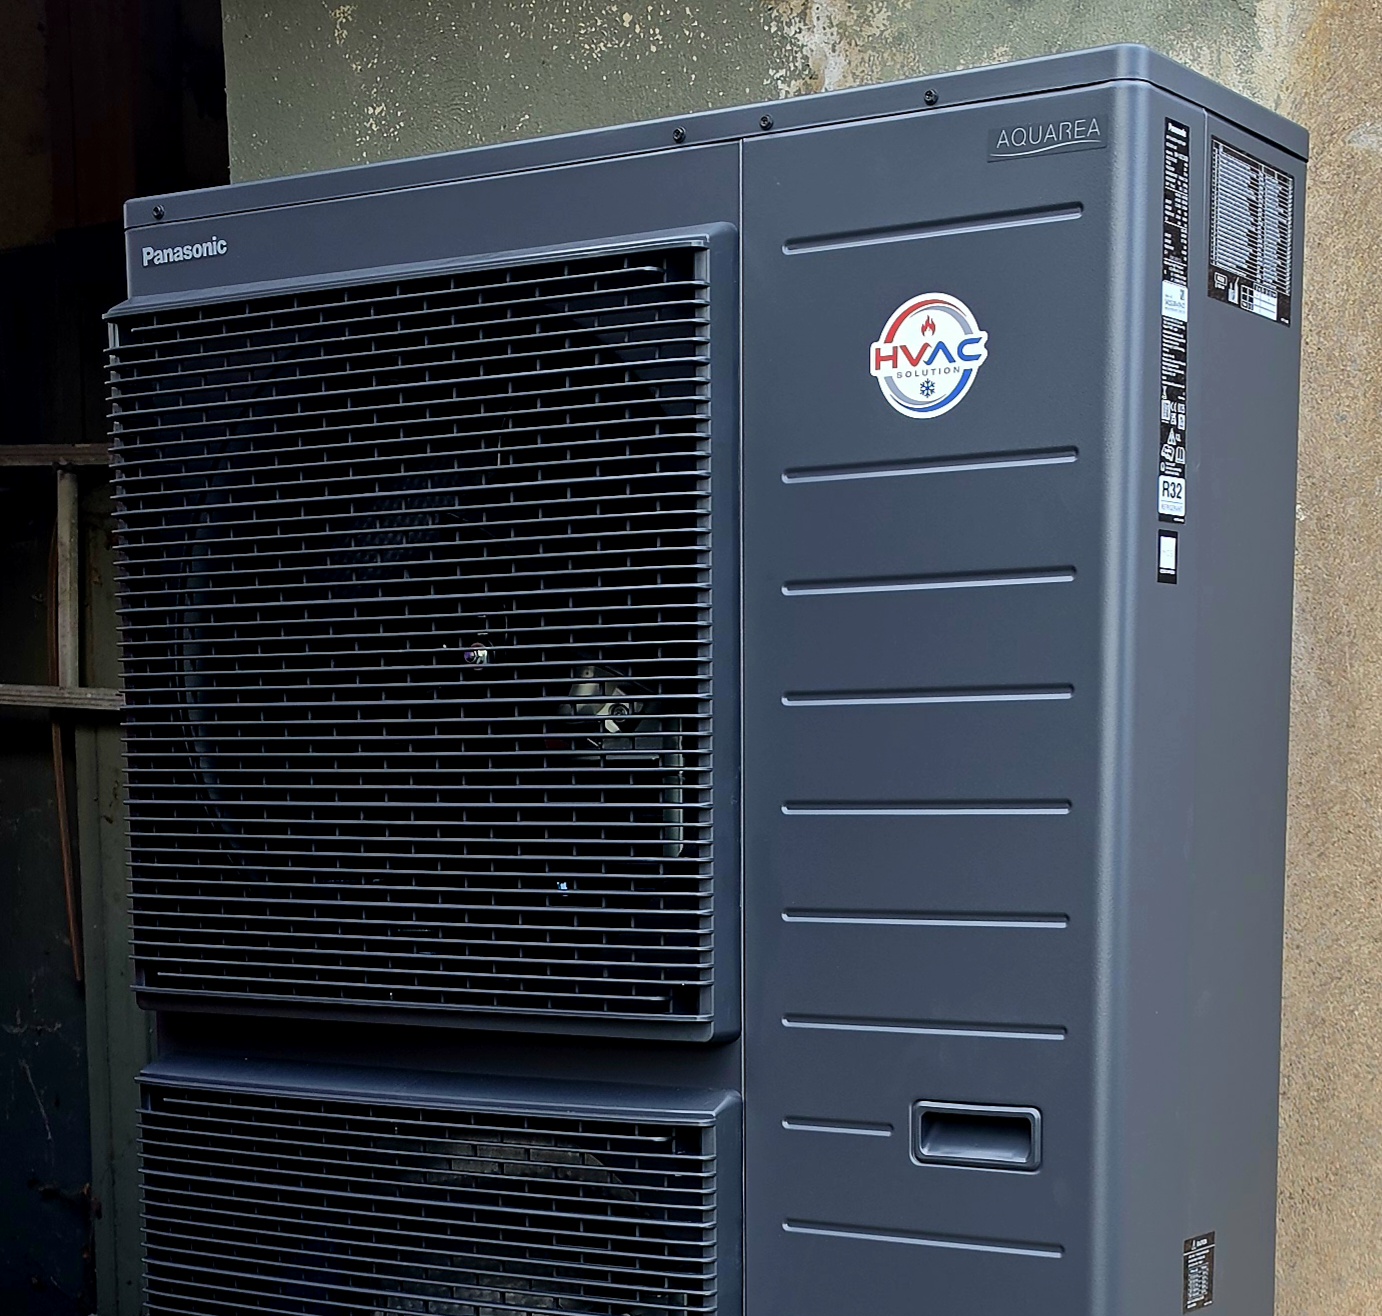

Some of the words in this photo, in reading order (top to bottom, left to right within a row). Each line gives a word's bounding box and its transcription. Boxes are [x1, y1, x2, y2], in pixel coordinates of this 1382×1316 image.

[996, 118, 1100, 149] AQUAREA
[142, 236, 227, 267] Panasonic
[875, 337, 982, 370] HVAC
[897, 366, 960, 379] SOLUTION
[1162, 480, 1183, 500] R32
